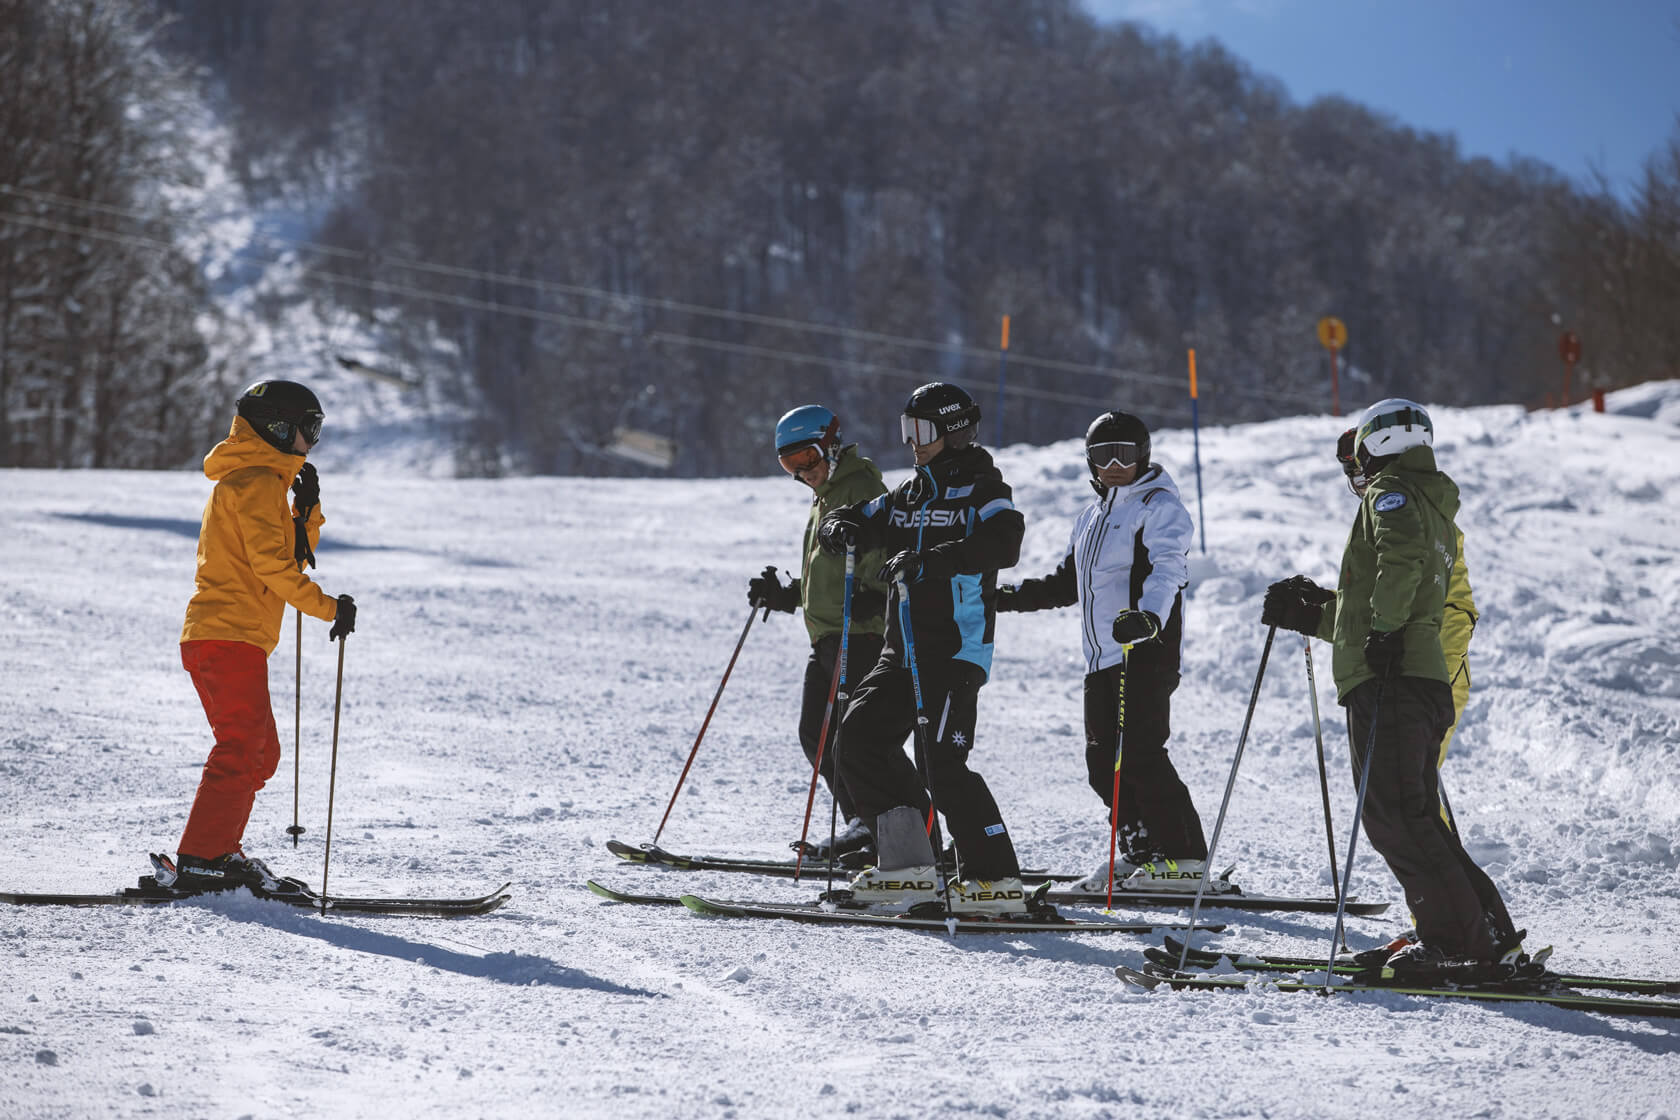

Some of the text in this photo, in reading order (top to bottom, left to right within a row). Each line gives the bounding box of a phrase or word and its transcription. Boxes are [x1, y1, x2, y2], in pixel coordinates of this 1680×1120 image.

[939, 402, 961, 415] uvex
[888, 505, 967, 528] RUSSIA
[866, 880, 934, 890] HEAD
[960, 890, 1023, 903] HEAD
